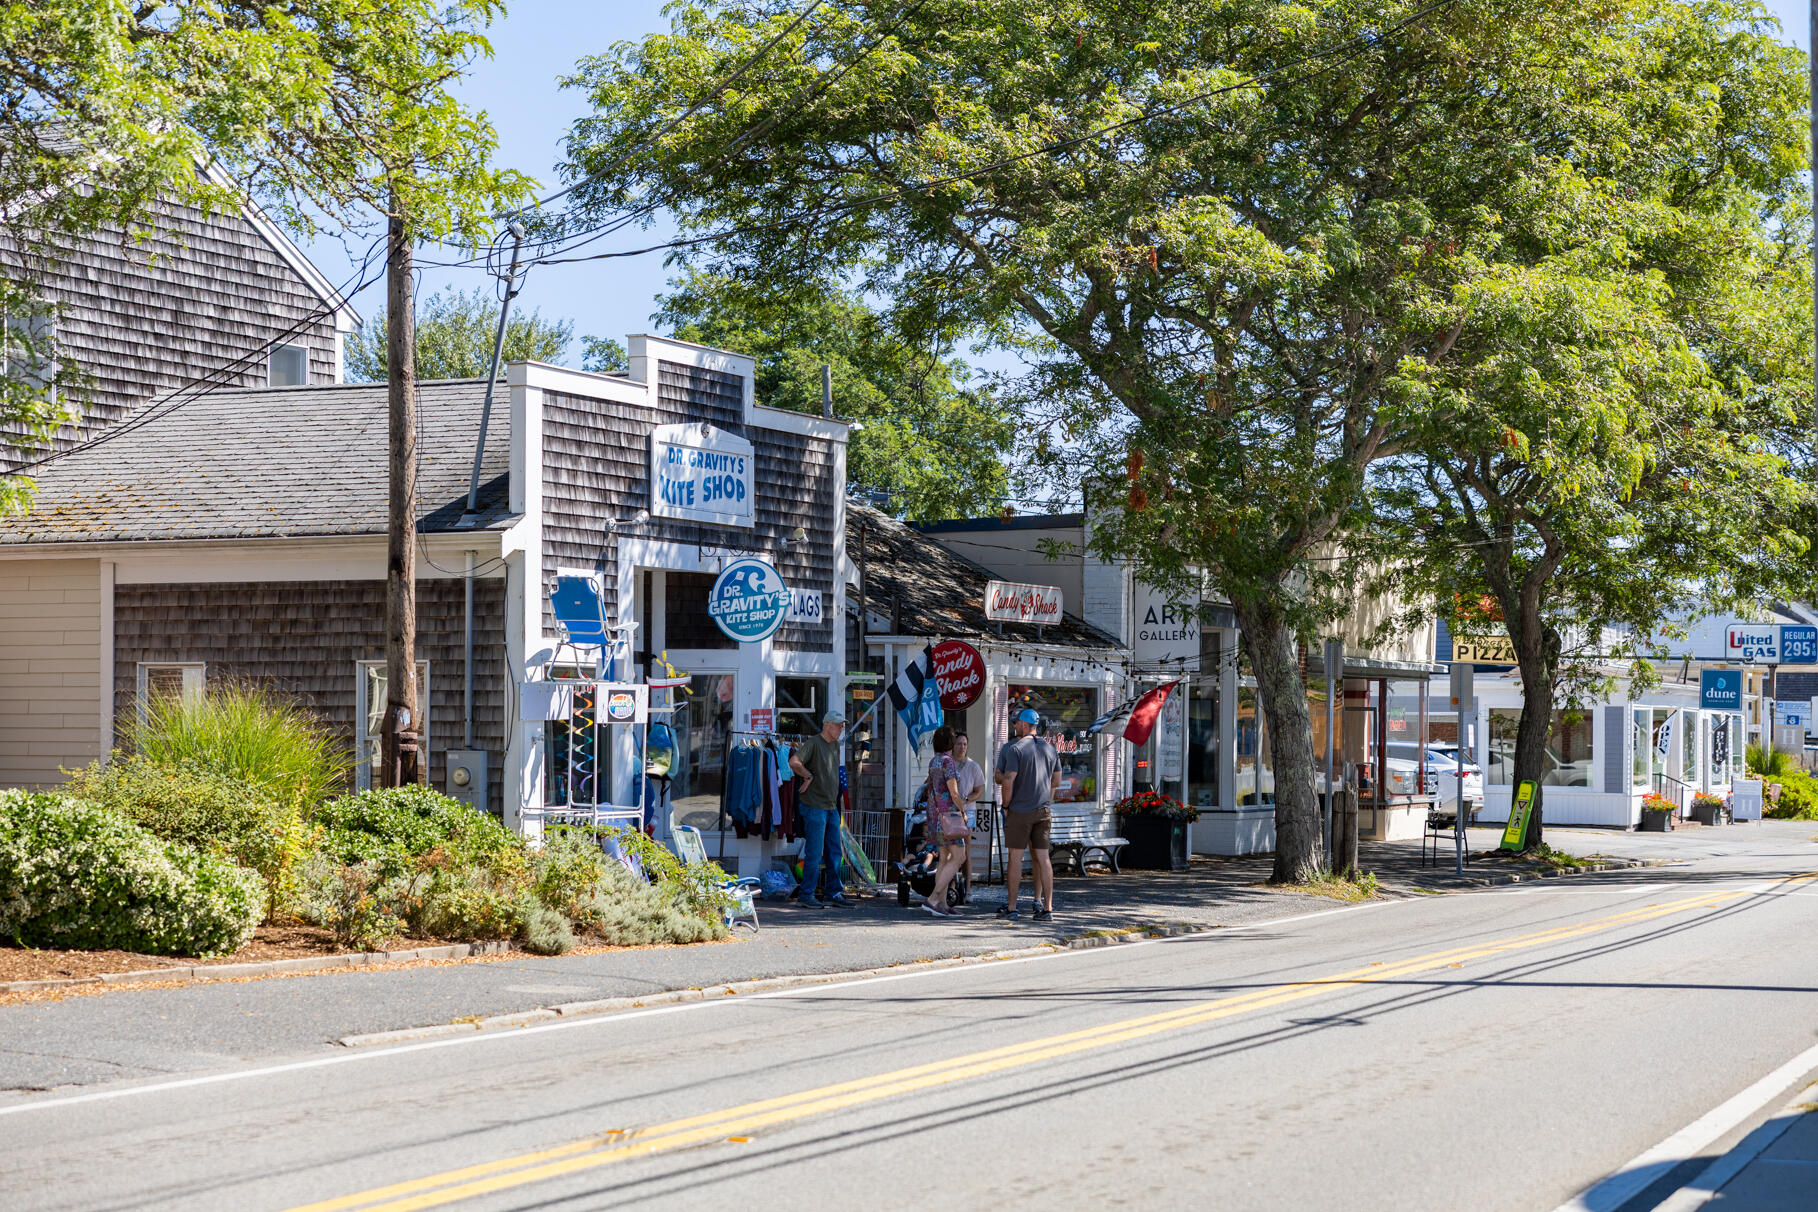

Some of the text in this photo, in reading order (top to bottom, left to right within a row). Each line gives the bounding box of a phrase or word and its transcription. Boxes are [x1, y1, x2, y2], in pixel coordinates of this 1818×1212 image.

[660, 475, 745, 506] KITE SHOP
[723, 585, 743, 598] DR.
[708, 591, 790, 615] GRAVITY'S
[792, 594, 820, 617] LAGS
[992, 589, 1058, 616] Candy Shack
[726, 609, 776, 624] KITE SHOP
[1139, 630, 1195, 641] GALLERY
[1730, 632, 1772, 648] United
[1784, 632, 1815, 640] REGULAR
[1457, 646, 1516, 661] PIZZA
[1743, 648, 1776, 657] GAS
[936, 669, 979, 697] Shack
[1706, 687, 1736, 699] dune
